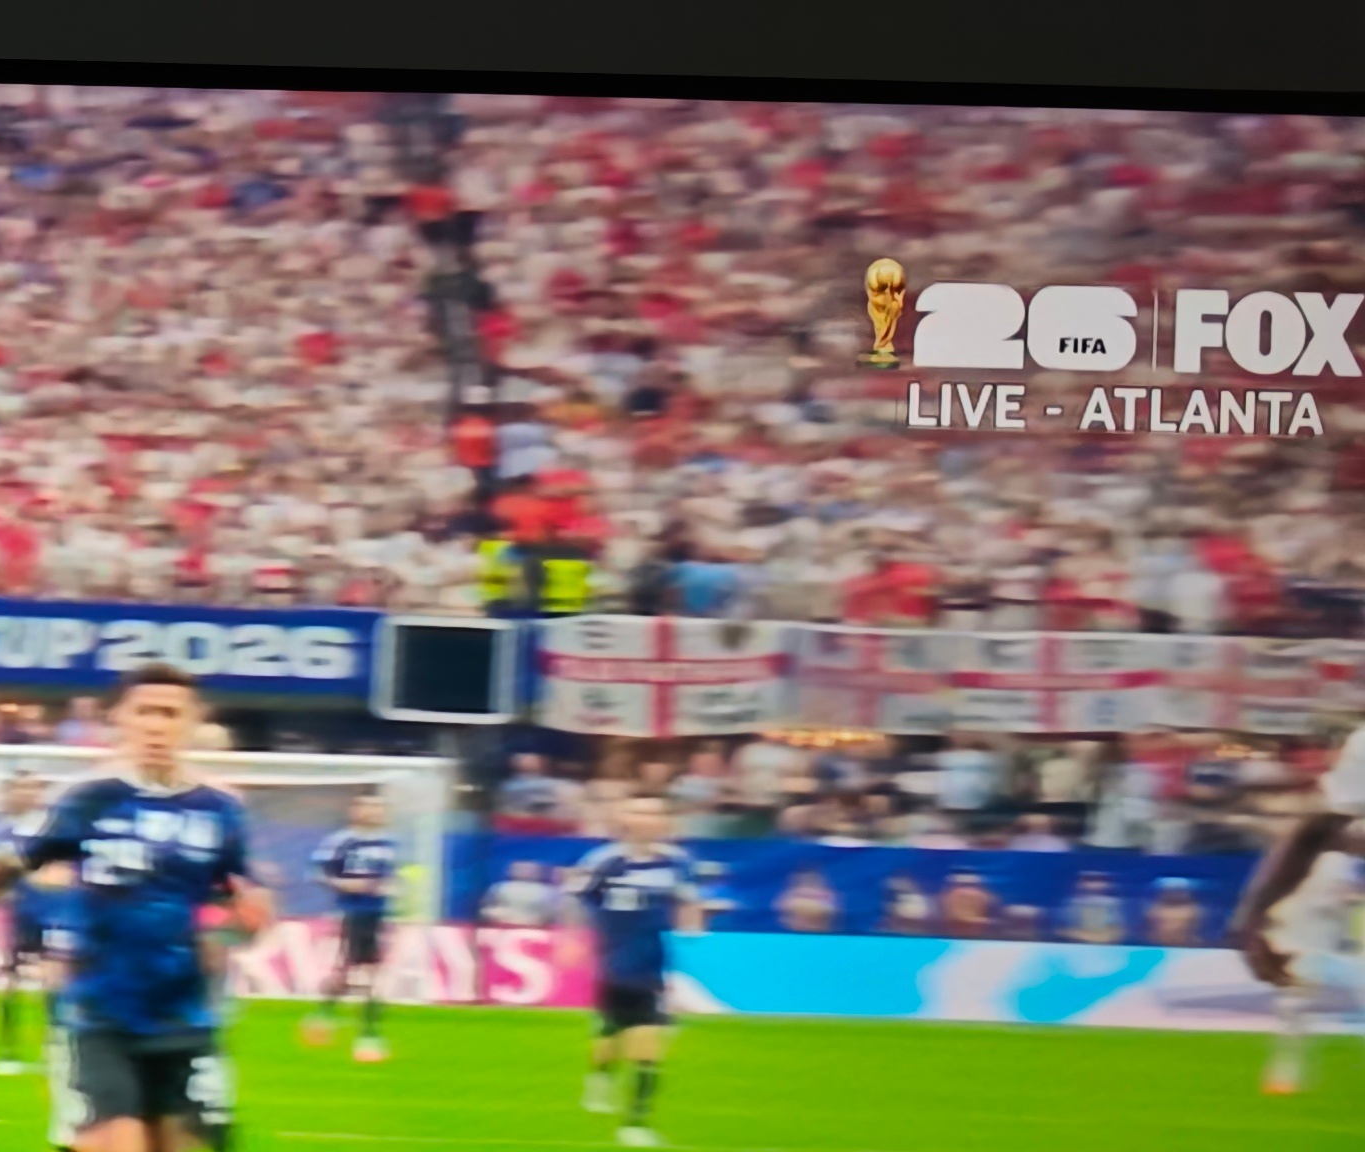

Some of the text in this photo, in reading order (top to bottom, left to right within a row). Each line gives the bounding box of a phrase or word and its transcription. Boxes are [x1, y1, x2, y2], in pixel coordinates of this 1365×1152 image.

[1058, 336, 1107, 355] FIFA
[1174, 289, 1364, 377] FOX
[908, 382, 1026, 429] LIVE
[1079, 387, 1324, 435] ATLANTA
[98, 619, 357, 679] 2026
